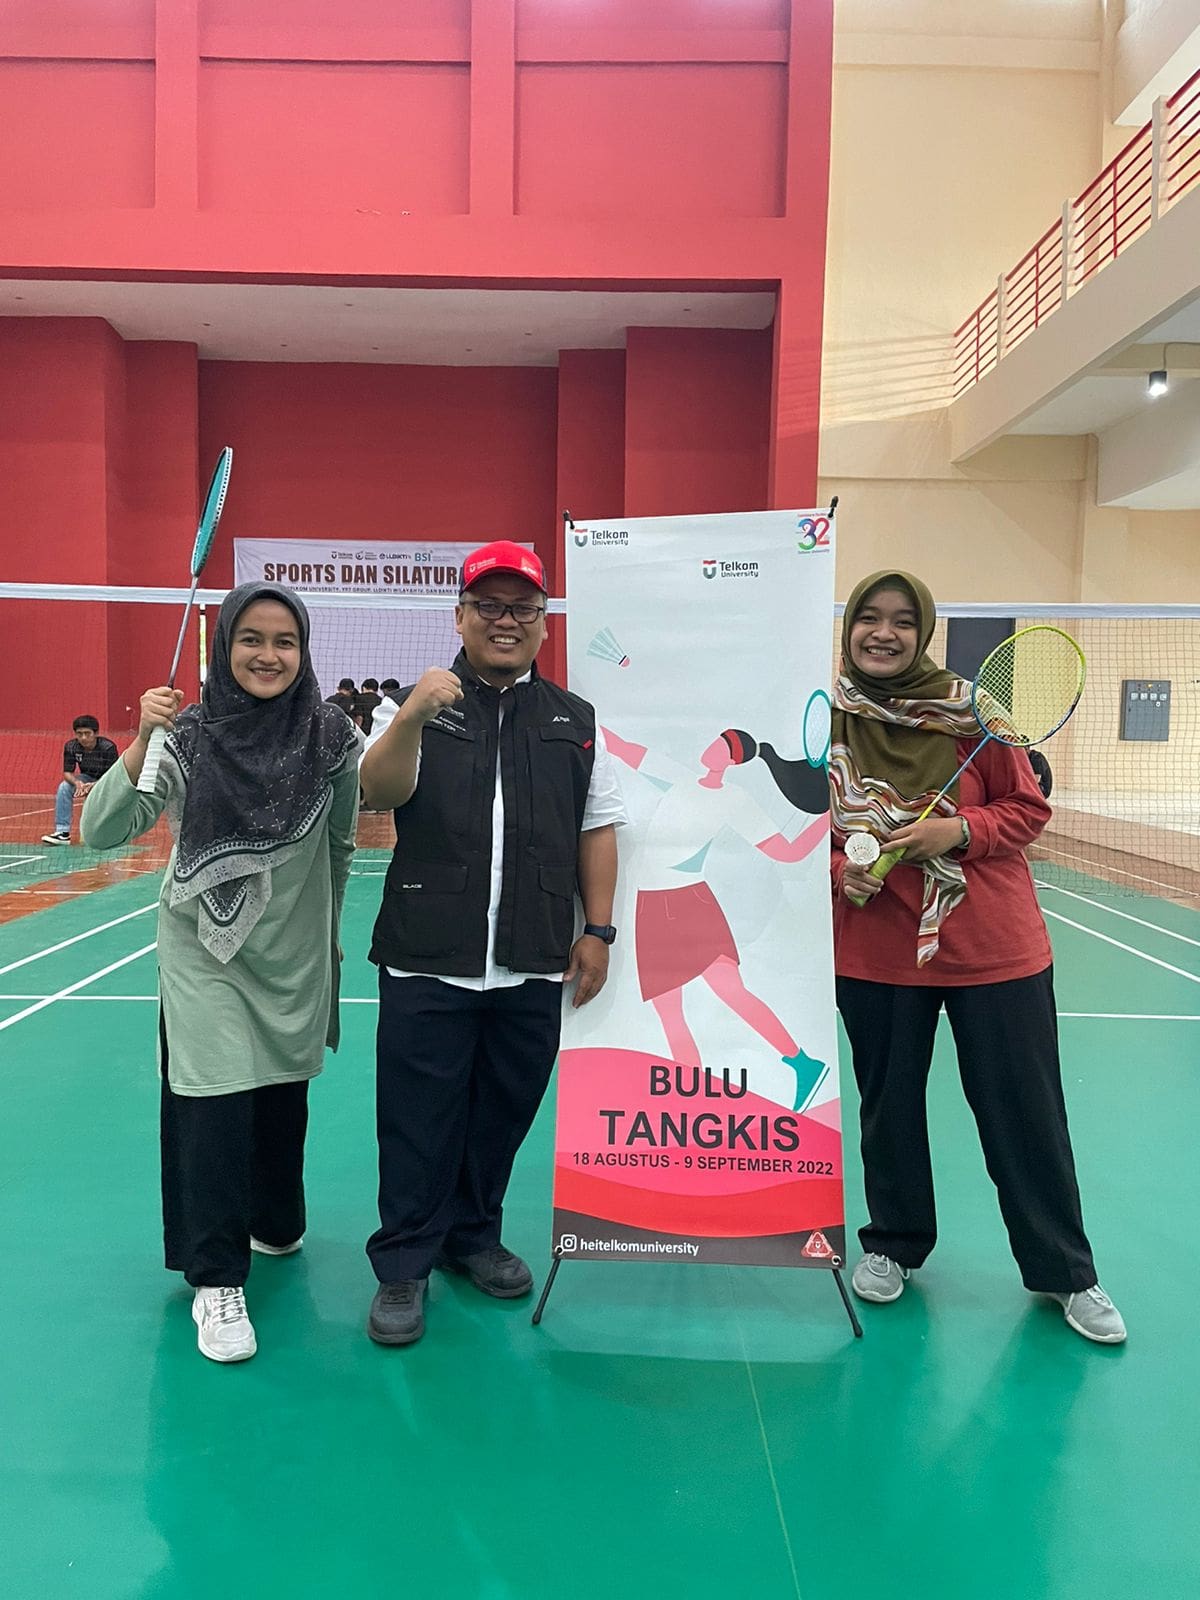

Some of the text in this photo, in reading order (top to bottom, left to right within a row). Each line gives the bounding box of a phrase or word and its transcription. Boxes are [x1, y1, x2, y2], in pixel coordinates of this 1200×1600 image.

[591, 530, 629, 540] Telkom
[591, 539, 629, 547] University
[798, 517, 830, 550] 32
[414, 552, 431, 562] BSI
[719, 561, 759, 573] Telkom
[264, 563, 462, 586] SPORTS DAN SILATUR
[650, 1066, 748, 1098] BULU
[599, 1110, 801, 1152] TANGKIS
[573, 1151, 590, 1166] 18
[594, 1153, 671, 1168] AGUSTUS
[684, 1155, 693, 1169] 9
[697, 1155, 793, 1173] SEPTEMBER
[797, 1160, 834, 1175] 2022
[579, 1238, 700, 1257] heitelkomuniversity
